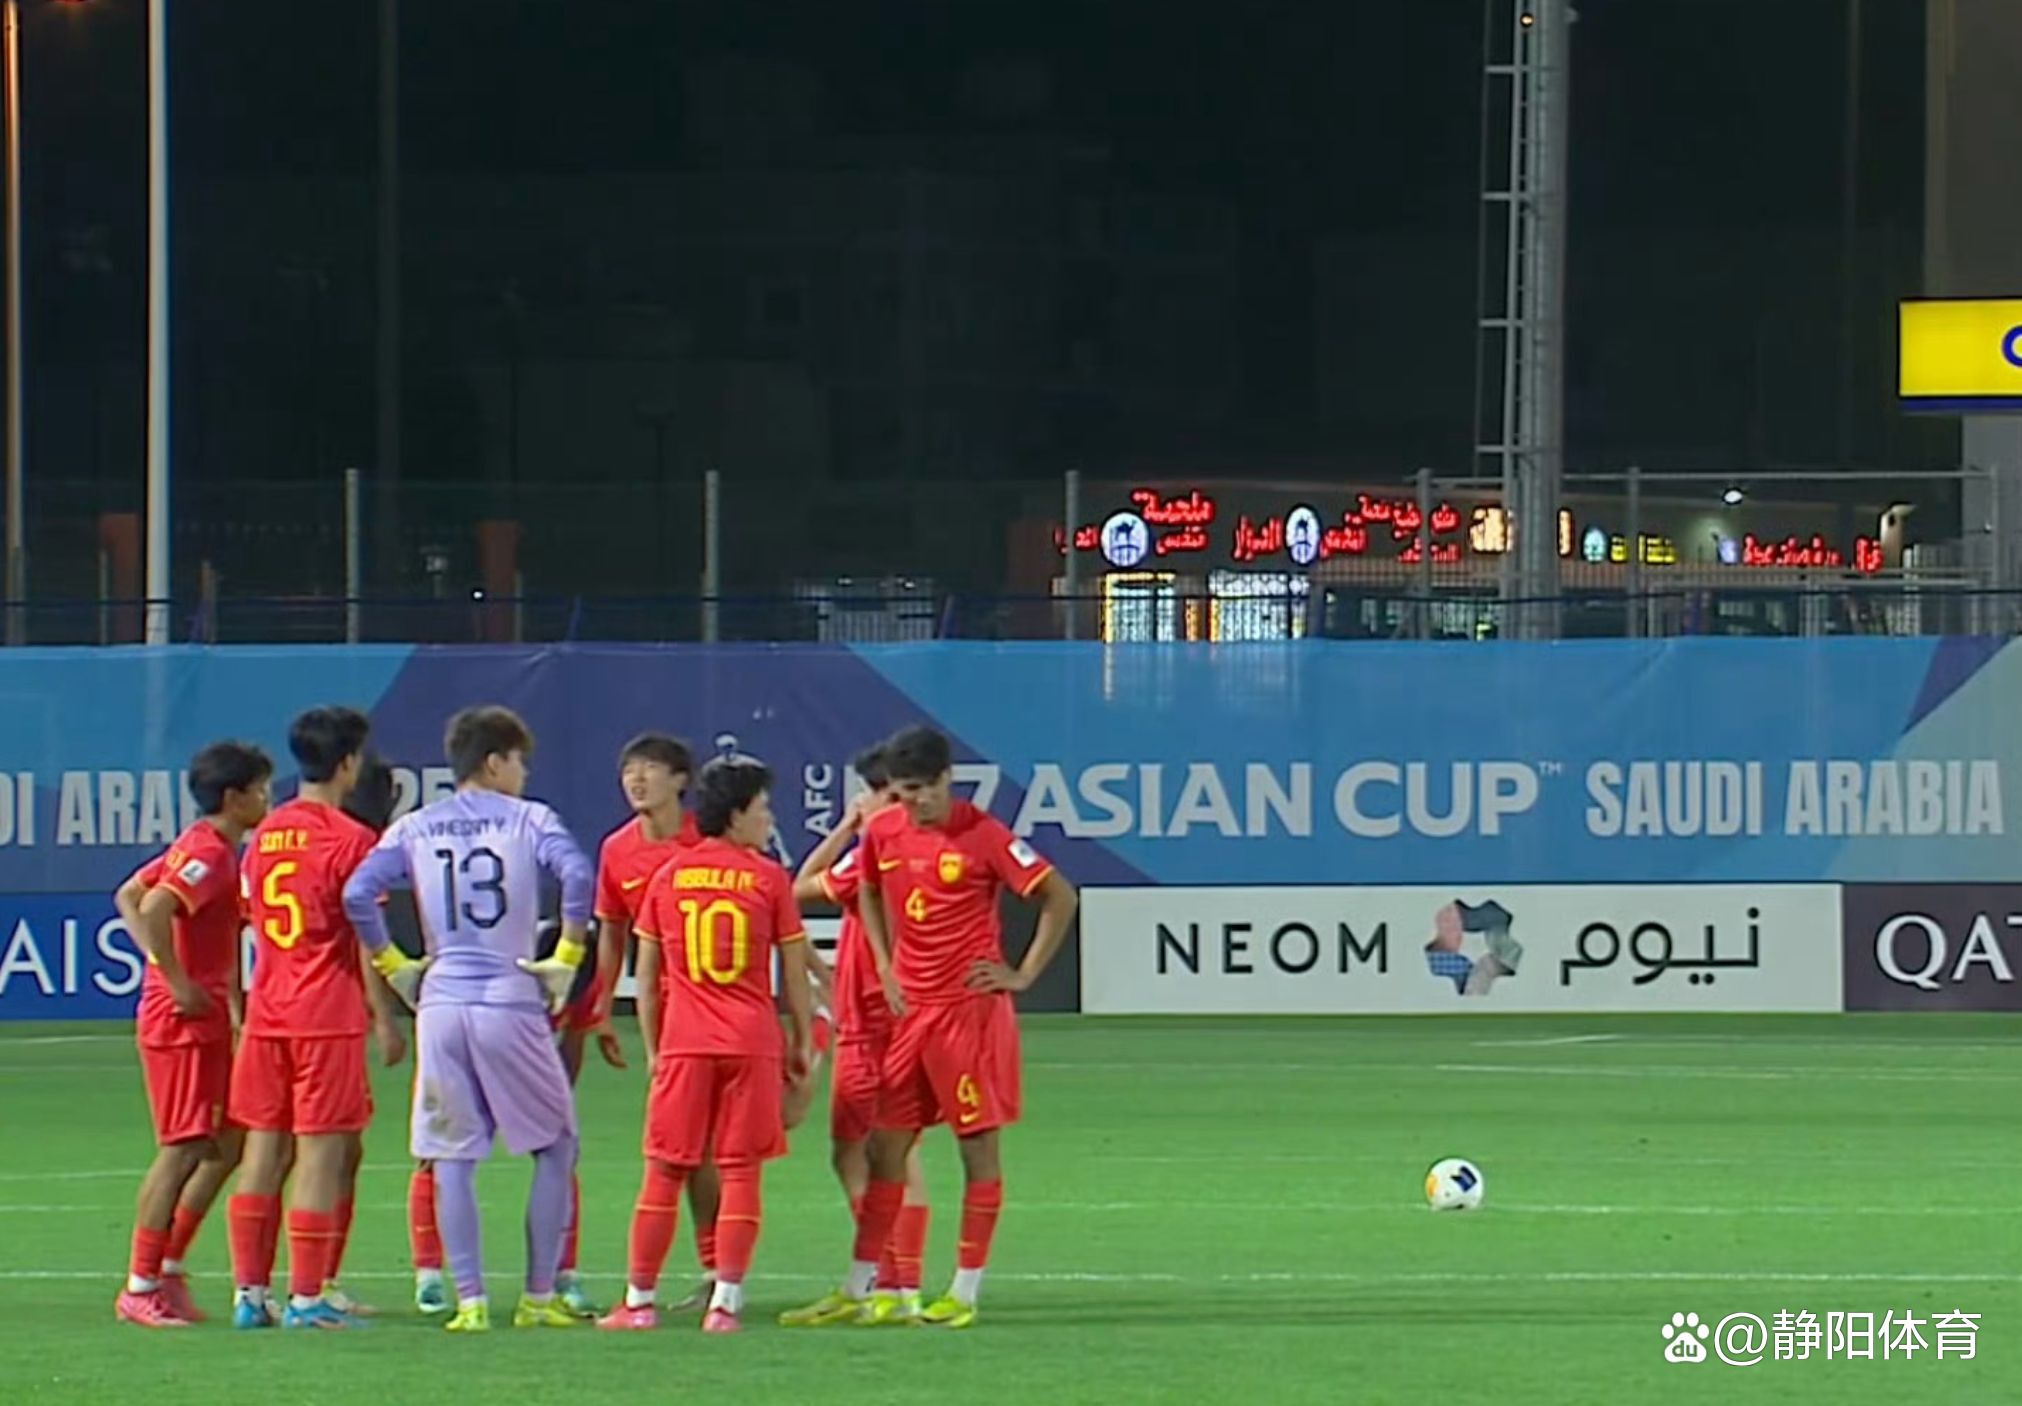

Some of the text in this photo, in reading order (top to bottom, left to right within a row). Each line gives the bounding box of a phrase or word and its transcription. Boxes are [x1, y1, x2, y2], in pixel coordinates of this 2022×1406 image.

[804, 763, 834, 837] AFC
[1011, 762, 1311, 838] ASIAN
[1585, 760, 2004, 836] SAUDI ARABIA
[262, 860, 304, 949] 5
[434, 846, 507, 932] 13
[905, 887, 926, 922] 4
[678, 899, 749, 984] 10
[1156, 922, 1388, 974] NEOM
[1560, 906, 1760, 987] نيوم
[957, 1073, 980, 1108] 4
